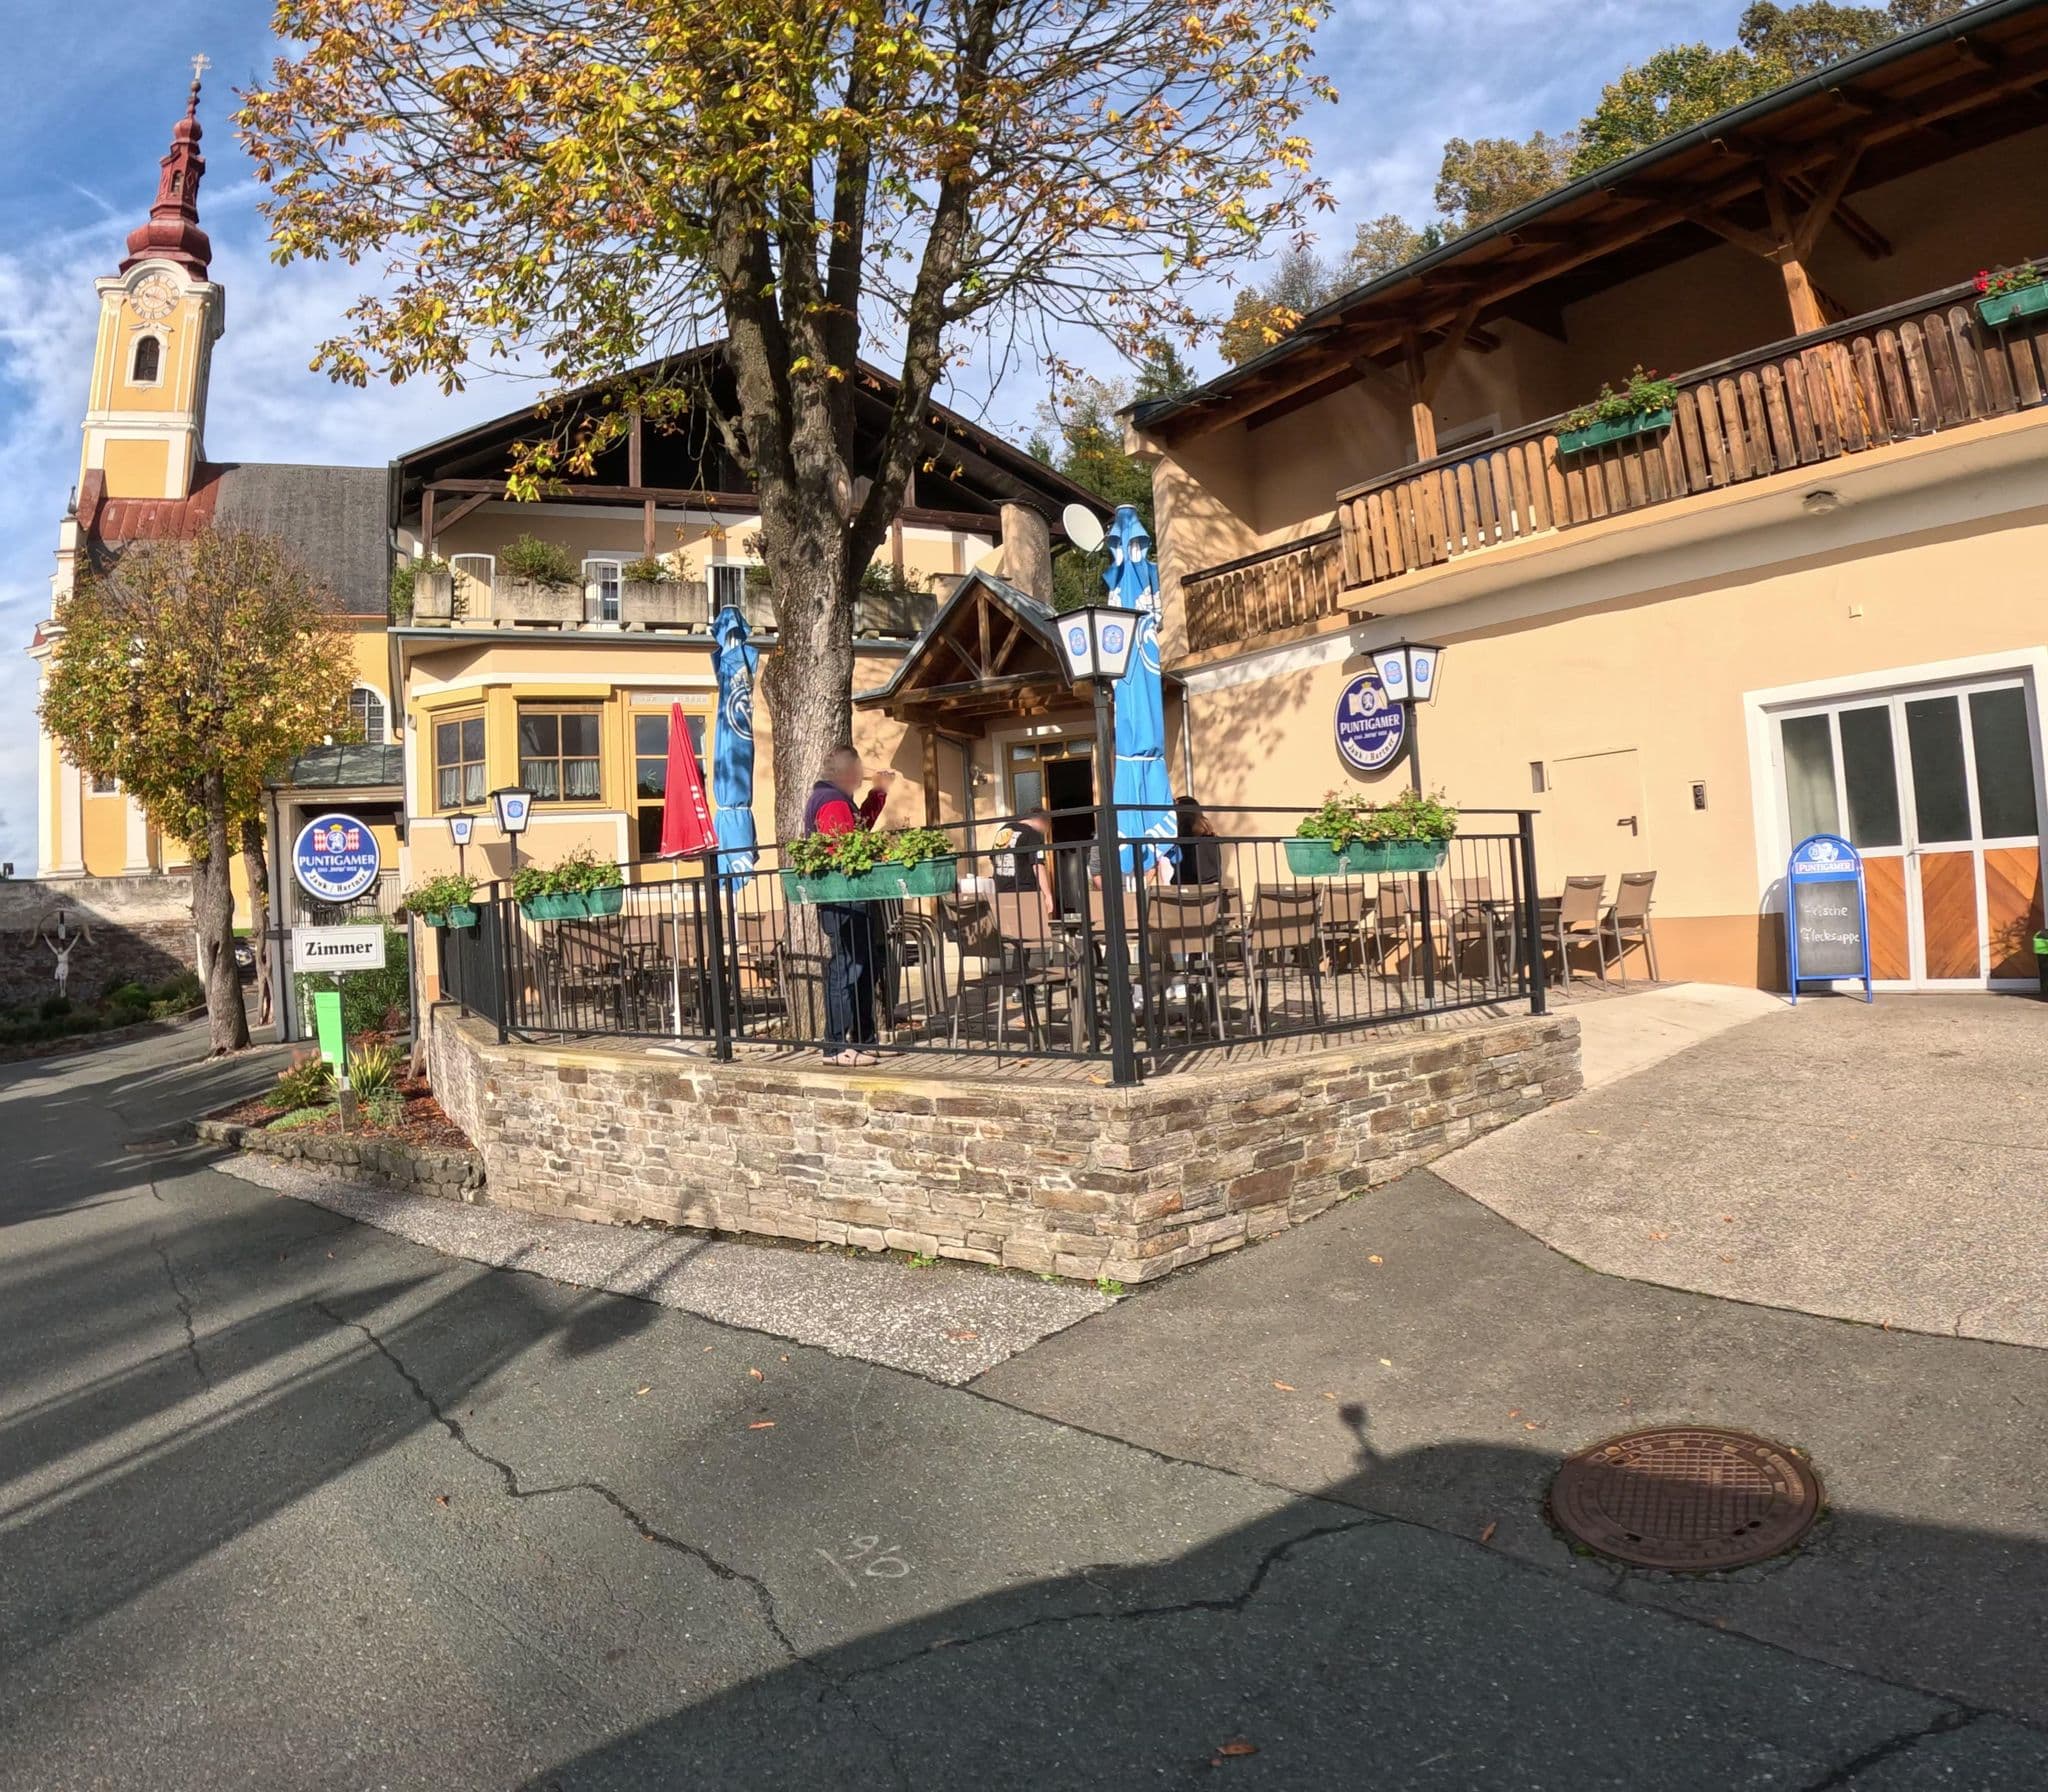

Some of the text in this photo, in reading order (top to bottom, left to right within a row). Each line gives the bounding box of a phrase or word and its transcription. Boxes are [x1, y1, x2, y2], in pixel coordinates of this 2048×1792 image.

[1340, 713, 1400, 735] PUNTIGAMER
[299, 854, 375, 866] PUNTIGAMER
[1799, 861, 1851, 872] PUNTIGAMER
[305, 941, 373, 956] Zimmer
